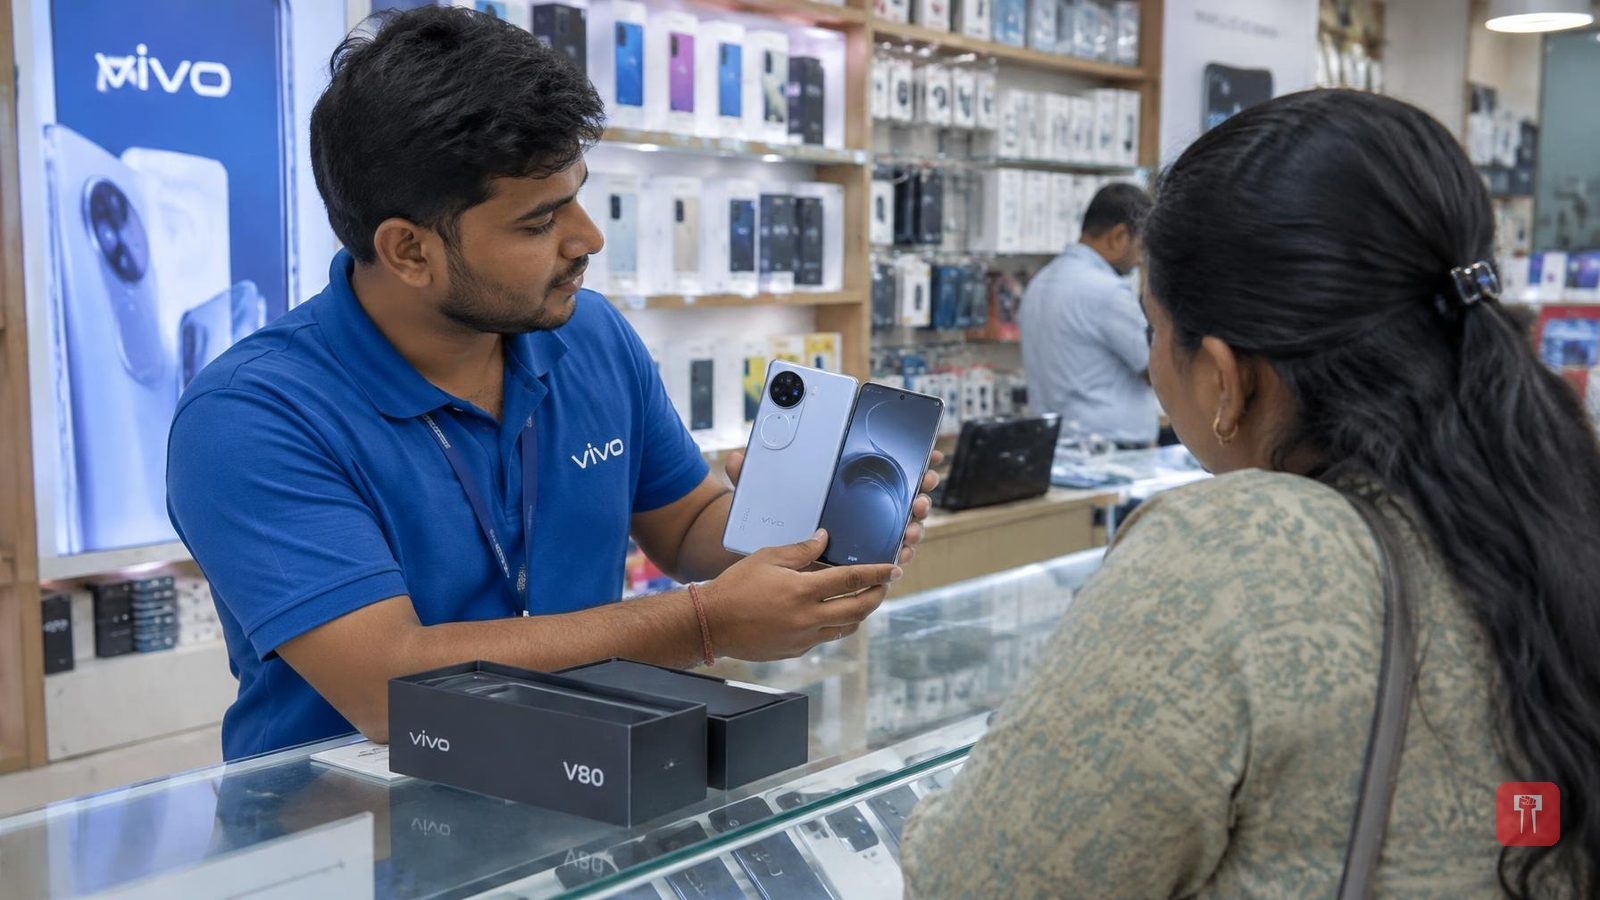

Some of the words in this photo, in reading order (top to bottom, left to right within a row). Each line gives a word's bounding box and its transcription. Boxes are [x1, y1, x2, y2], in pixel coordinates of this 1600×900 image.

[571, 438, 623, 469] vivo
[761, 516, 784, 528] vivo
[409, 729, 450, 751] vivo
[563, 761, 604, 787] V80
